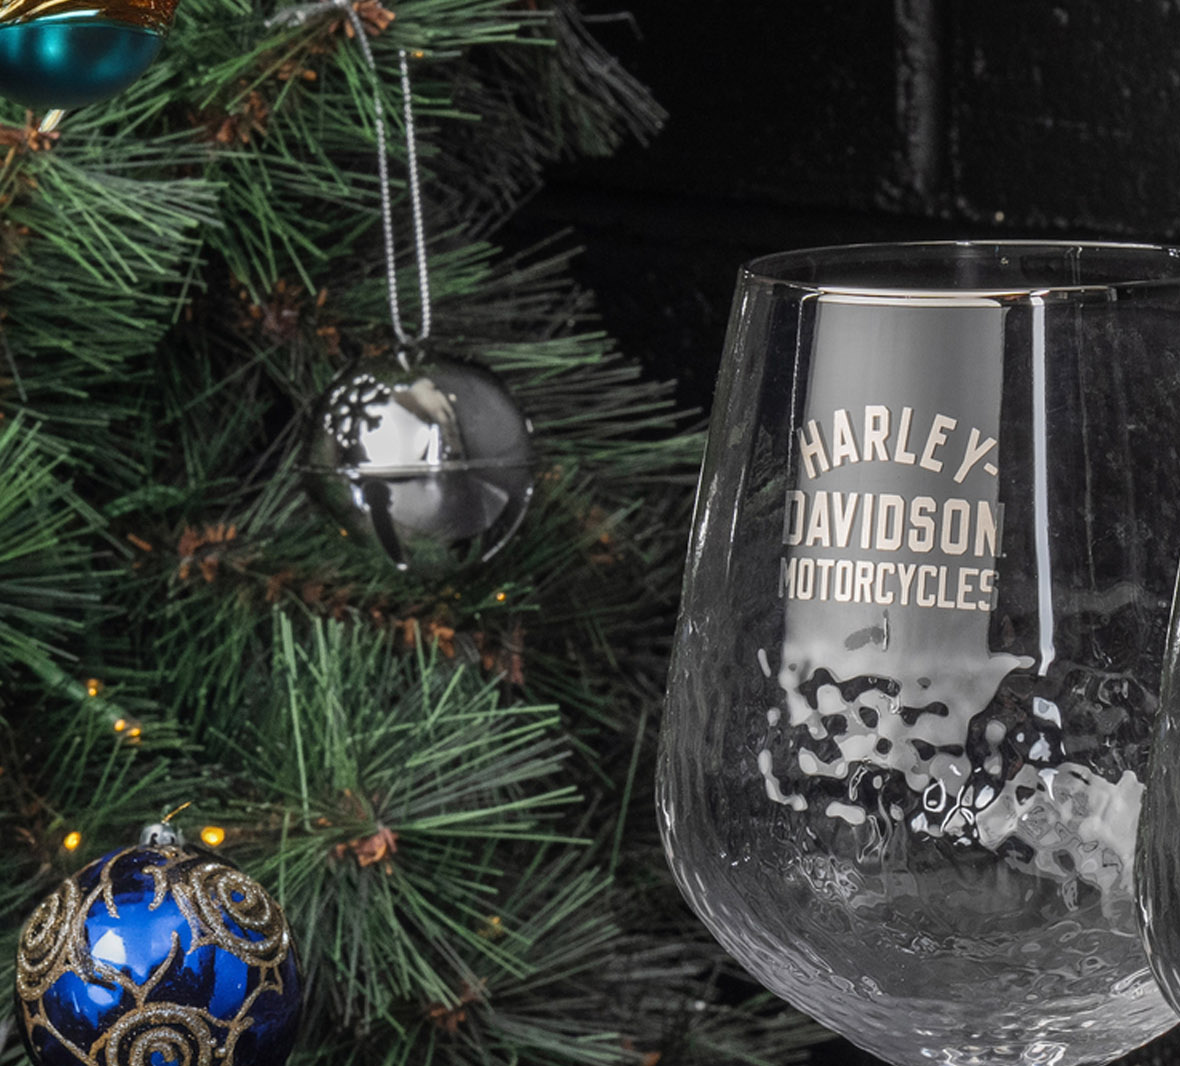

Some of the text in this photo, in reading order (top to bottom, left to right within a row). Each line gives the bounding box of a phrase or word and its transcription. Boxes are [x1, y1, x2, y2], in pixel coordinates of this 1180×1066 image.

[797, 405, 999, 484] HARLEY-
[782, 490, 1005, 557] DAVIDSON
[778, 557, 999, 611] MOTORCYCLES
